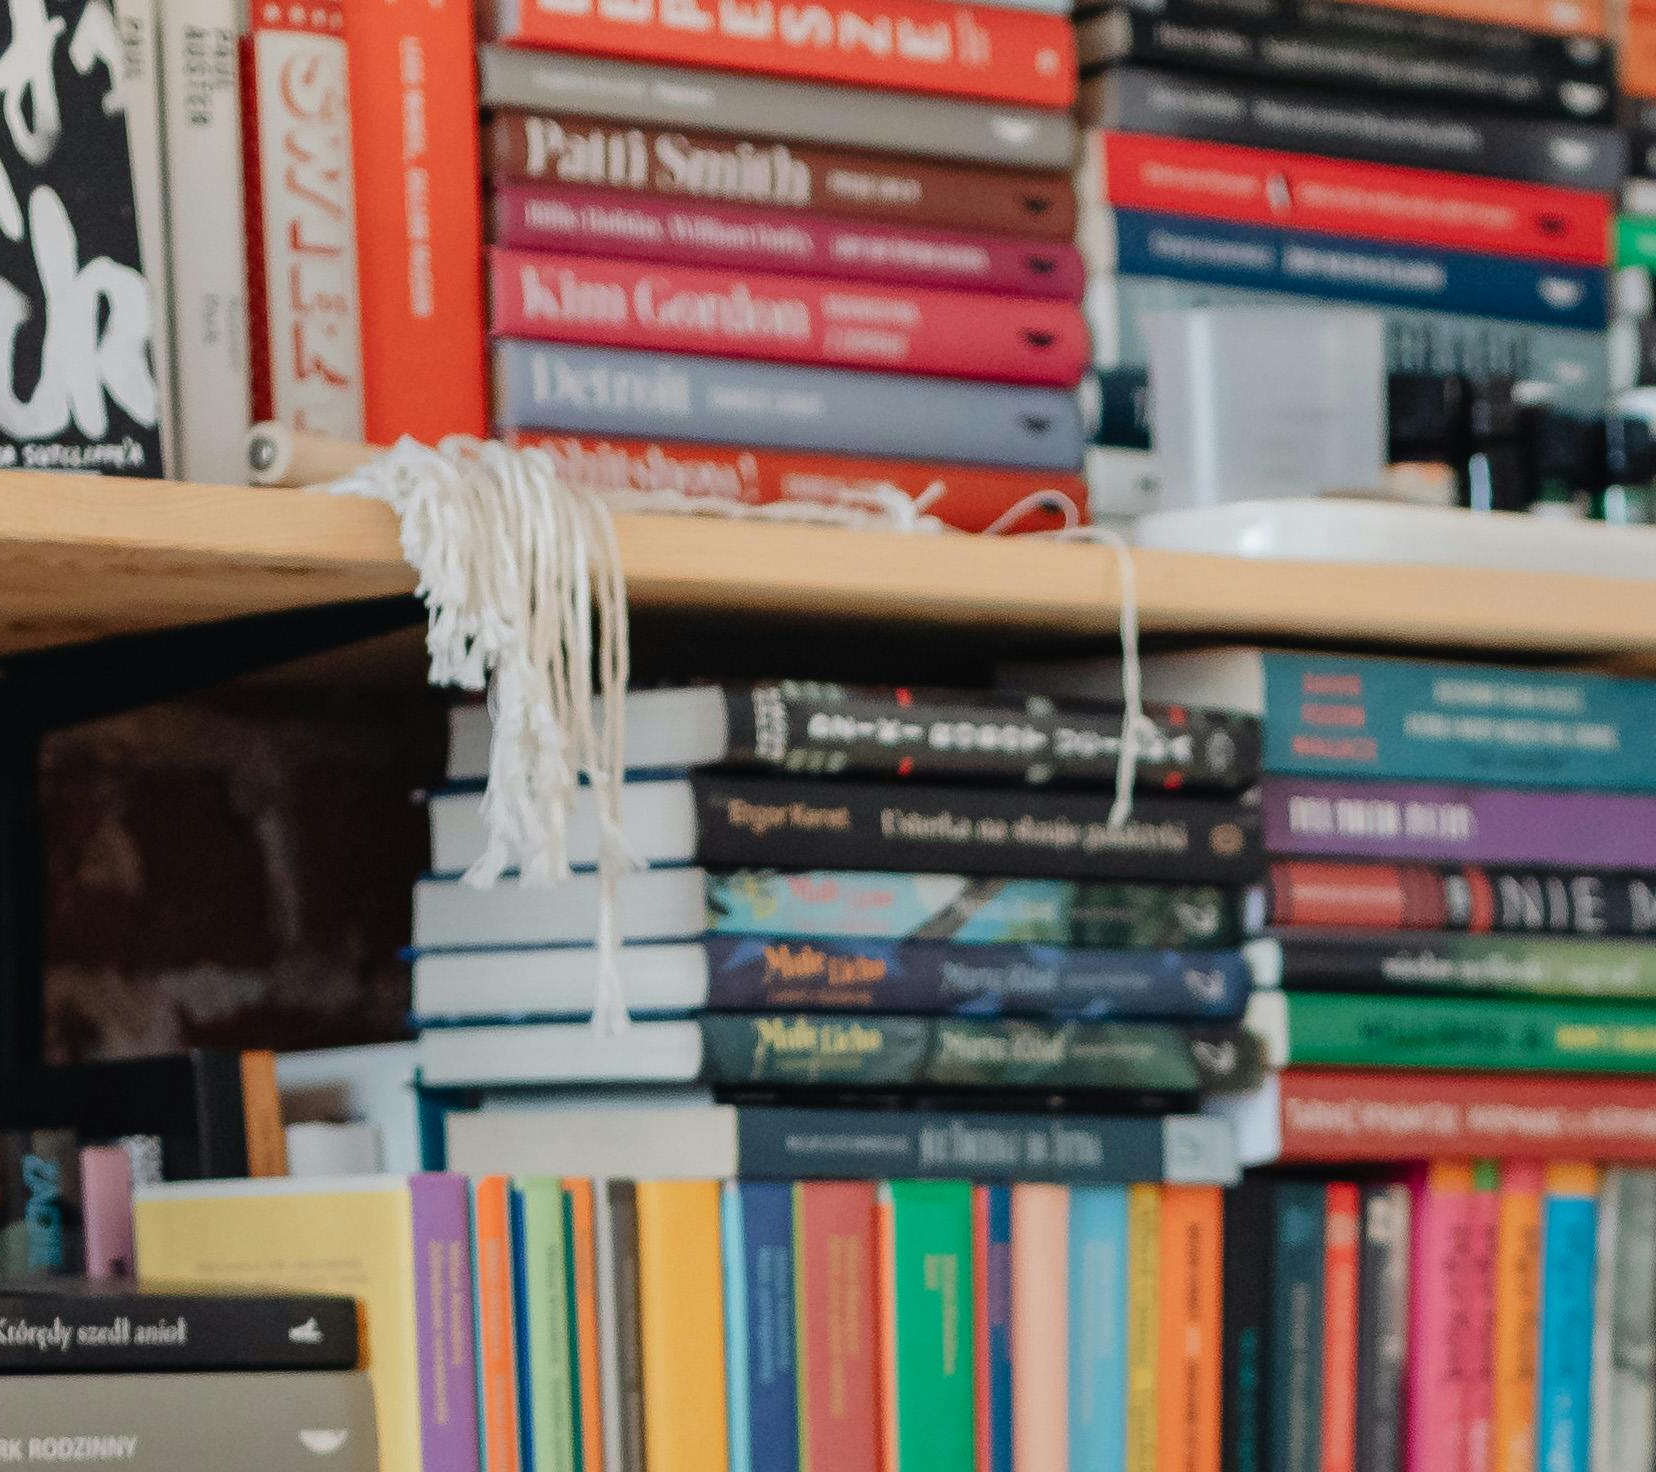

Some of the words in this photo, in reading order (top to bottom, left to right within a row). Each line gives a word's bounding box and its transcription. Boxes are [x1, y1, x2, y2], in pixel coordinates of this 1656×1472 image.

[525, 116, 648, 188] Patti
[656, 133, 811, 207] Smith
[521, 265, 628, 326] Kim
[635, 278, 811, 342] Gordon
[1500, 873, 1607, 932] NIE
[77, 1317, 129, 1345] szedł
[28, 1434, 138, 1463] RODZINNY
